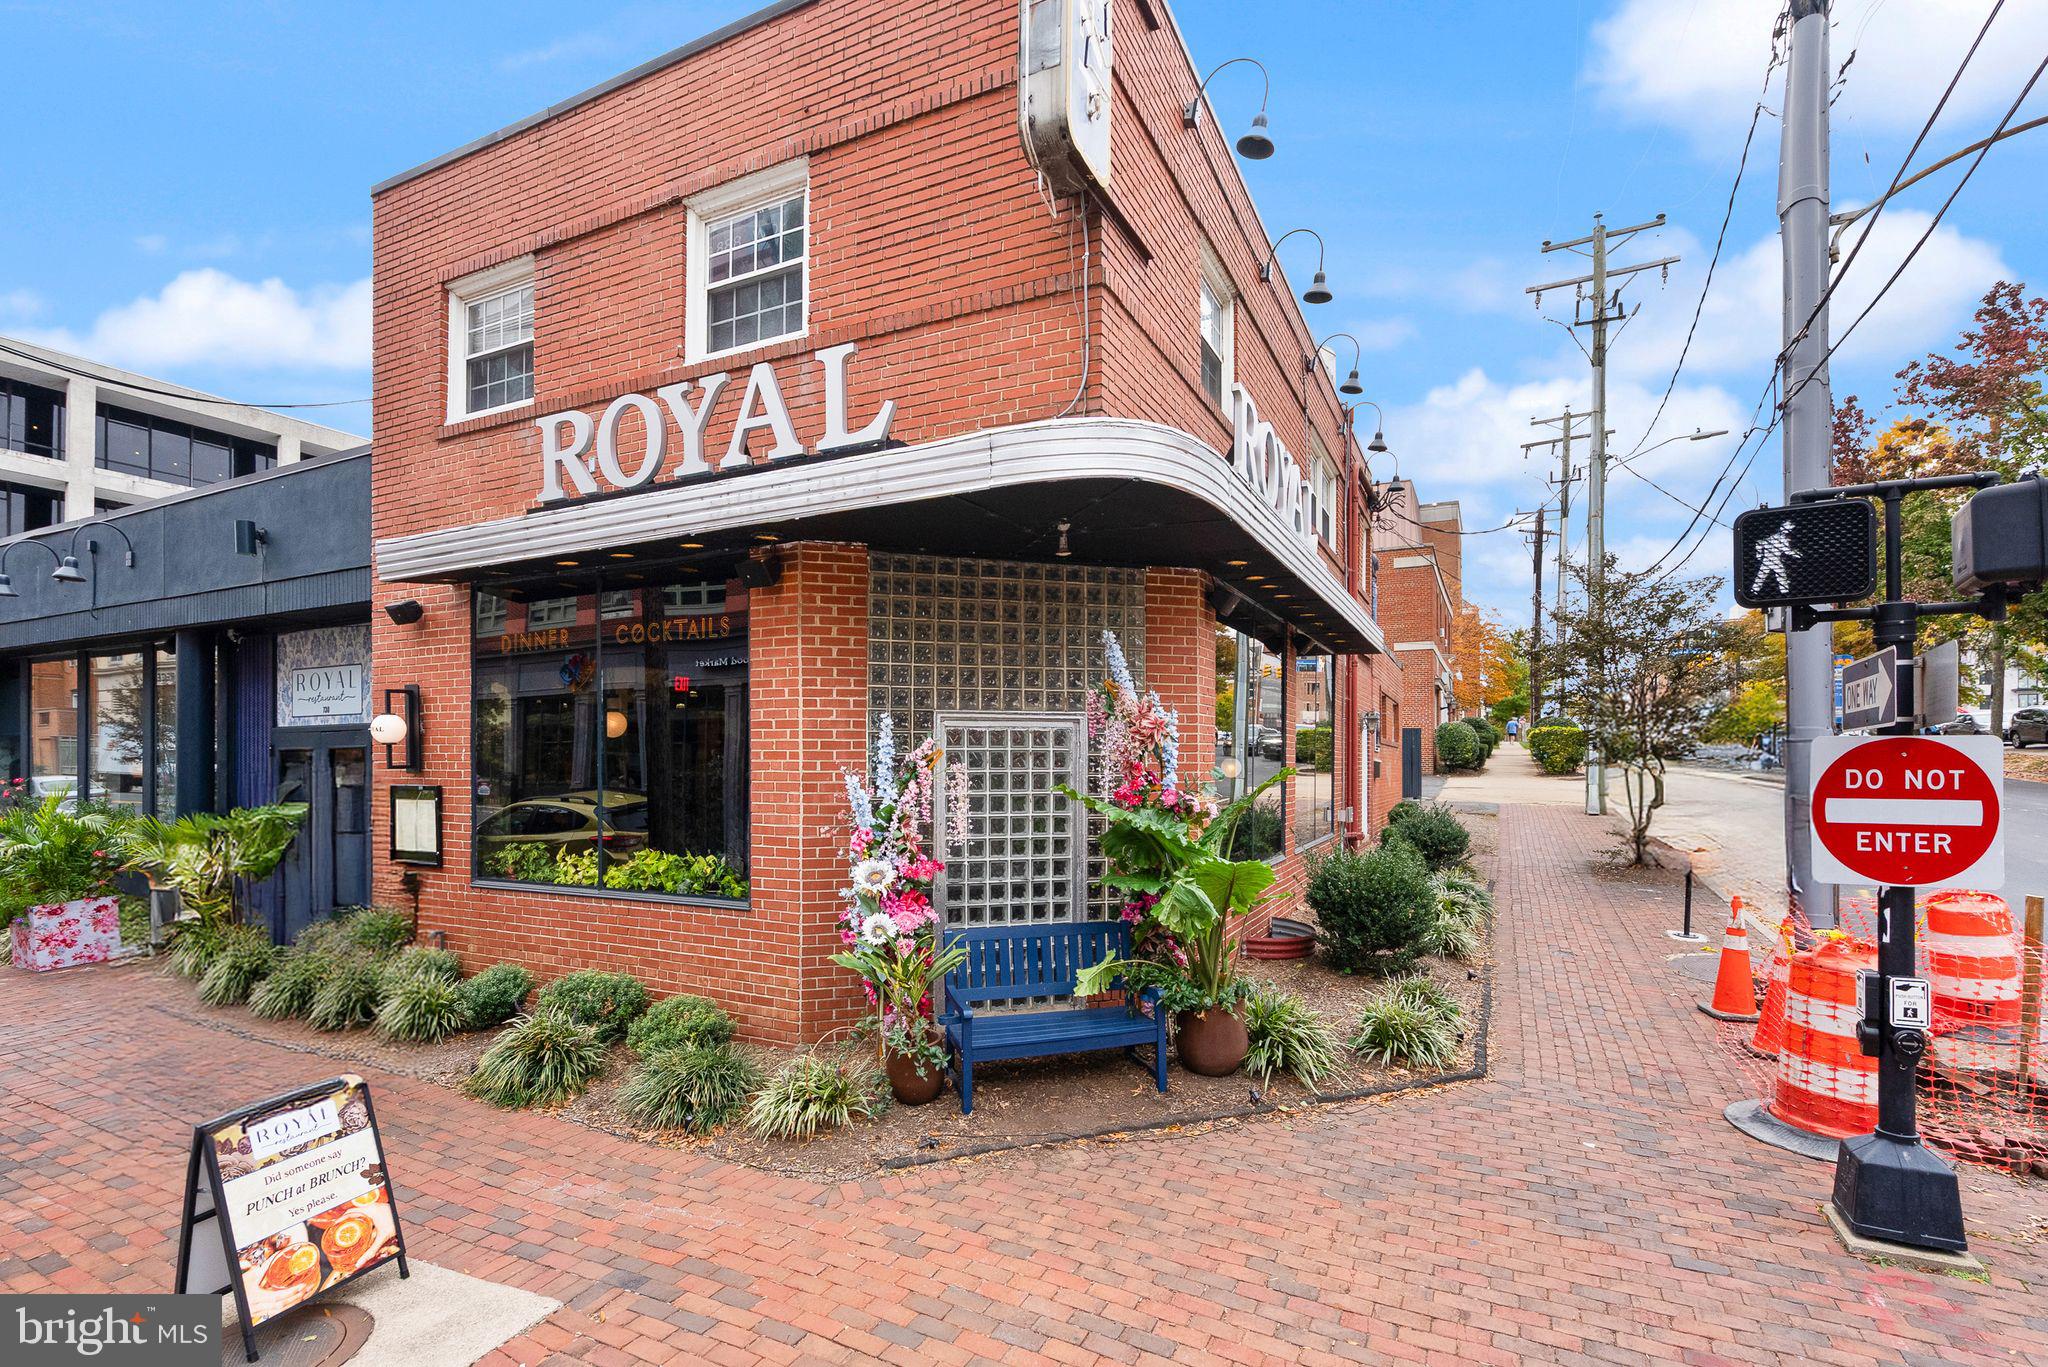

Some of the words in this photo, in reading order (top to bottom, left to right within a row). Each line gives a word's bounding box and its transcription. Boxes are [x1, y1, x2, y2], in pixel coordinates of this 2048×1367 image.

[535, 342, 898, 503] ROYAL
[1231, 382, 1318, 553] ROYAL
[500, 628, 569, 655] DINNER
[615, 615, 731, 645] COCKTAILS
[296, 669, 357, 692] ROYAL
[674, 676, 690, 691] EXIT
[1846, 683, 1861, 710] ONE
[1862, 677, 1878, 707] WAY
[303, 690, 350, 704] restaurant
[1845, 768, 1884, 790] DO
[1904, 769, 1965, 790] NOT
[1856, 831, 1952, 855] ENTER
[256, 1105, 327, 1143] ROYAL
[264, 1171, 282, 1186] Did
[283, 1156, 326, 1178] someone
[327, 1150, 343, 1162] say
[246, 1187, 294, 1216] PUNCH
[295, 1183, 306, 1195] at
[309, 1156, 366, 1190] BRUNCH?
[288, 1206, 305, 1218] Yes
[306, 1193, 338, 1213] please.
